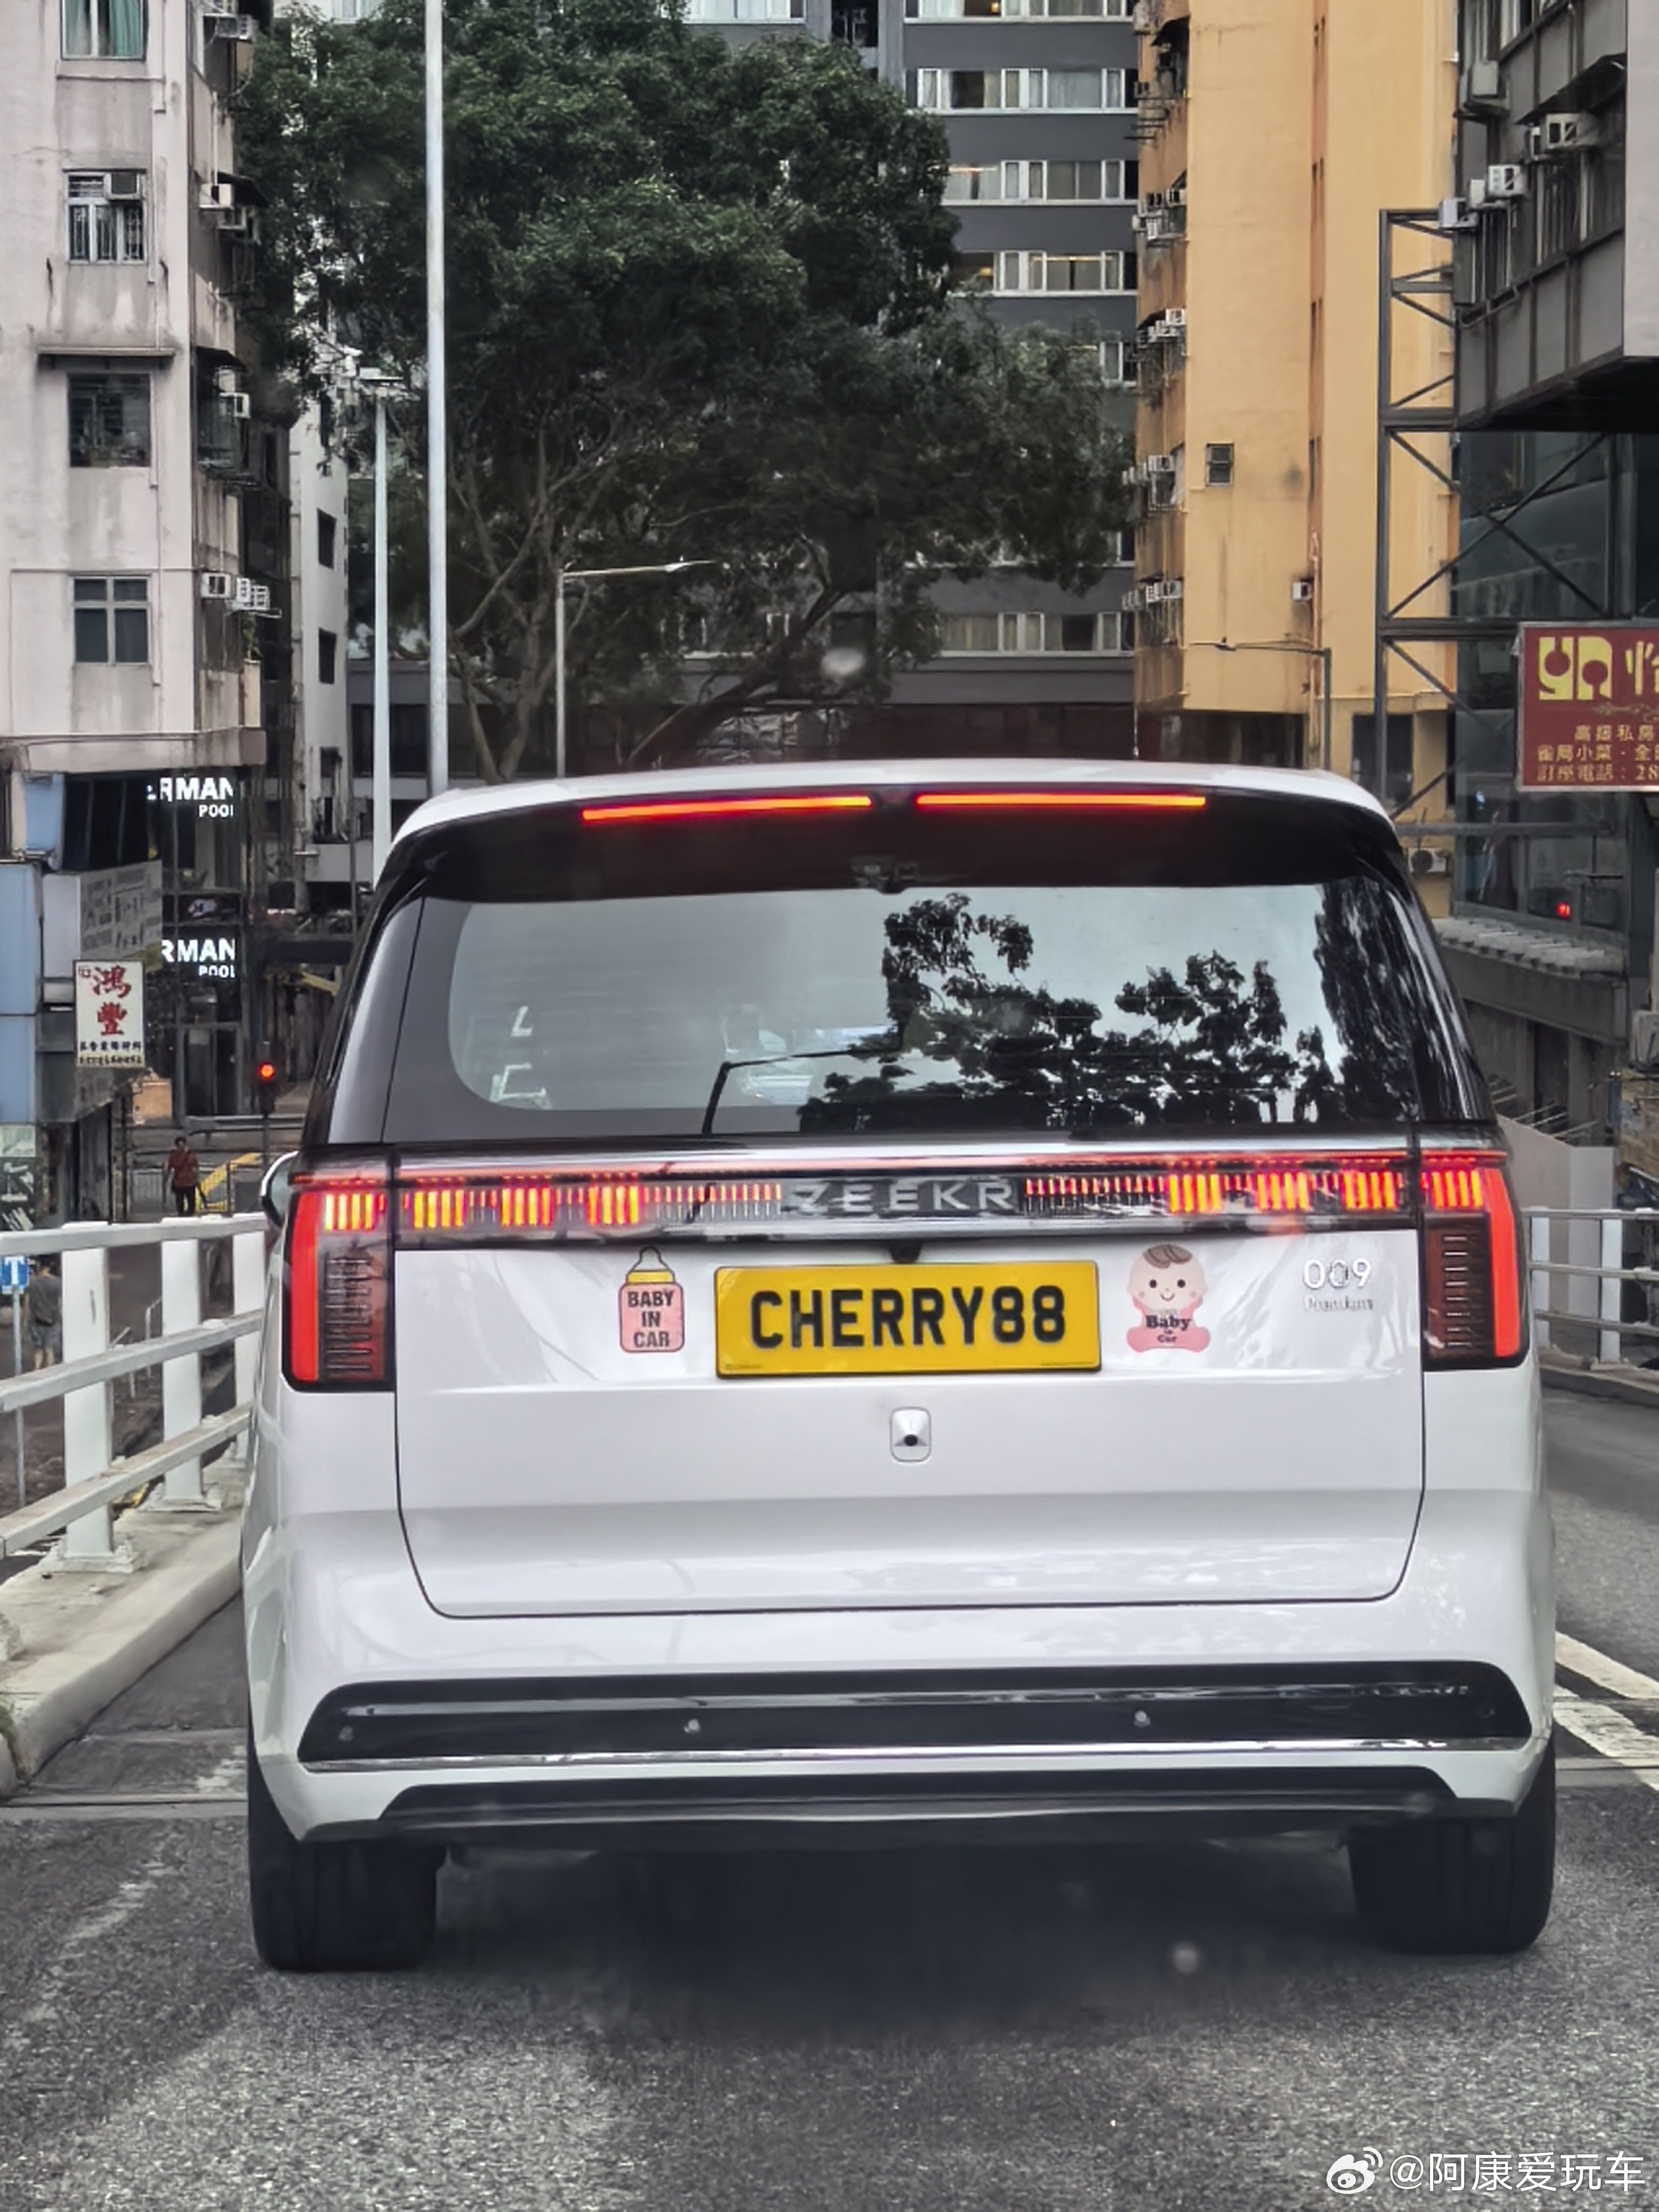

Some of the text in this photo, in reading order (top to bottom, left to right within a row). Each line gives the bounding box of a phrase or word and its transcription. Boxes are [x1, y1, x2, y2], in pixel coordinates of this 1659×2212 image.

[790, 1182, 1014, 1213] ZEEKR
[1303, 1258, 1371, 1290] 009
[628, 1289, 674, 1307] BABY
[642, 1311, 660, 1327] IN
[751, 1285, 1065, 1348] CHERRY88
[1145, 1314, 1192, 1331] Baby
[633, 1331, 670, 1348] CAR
